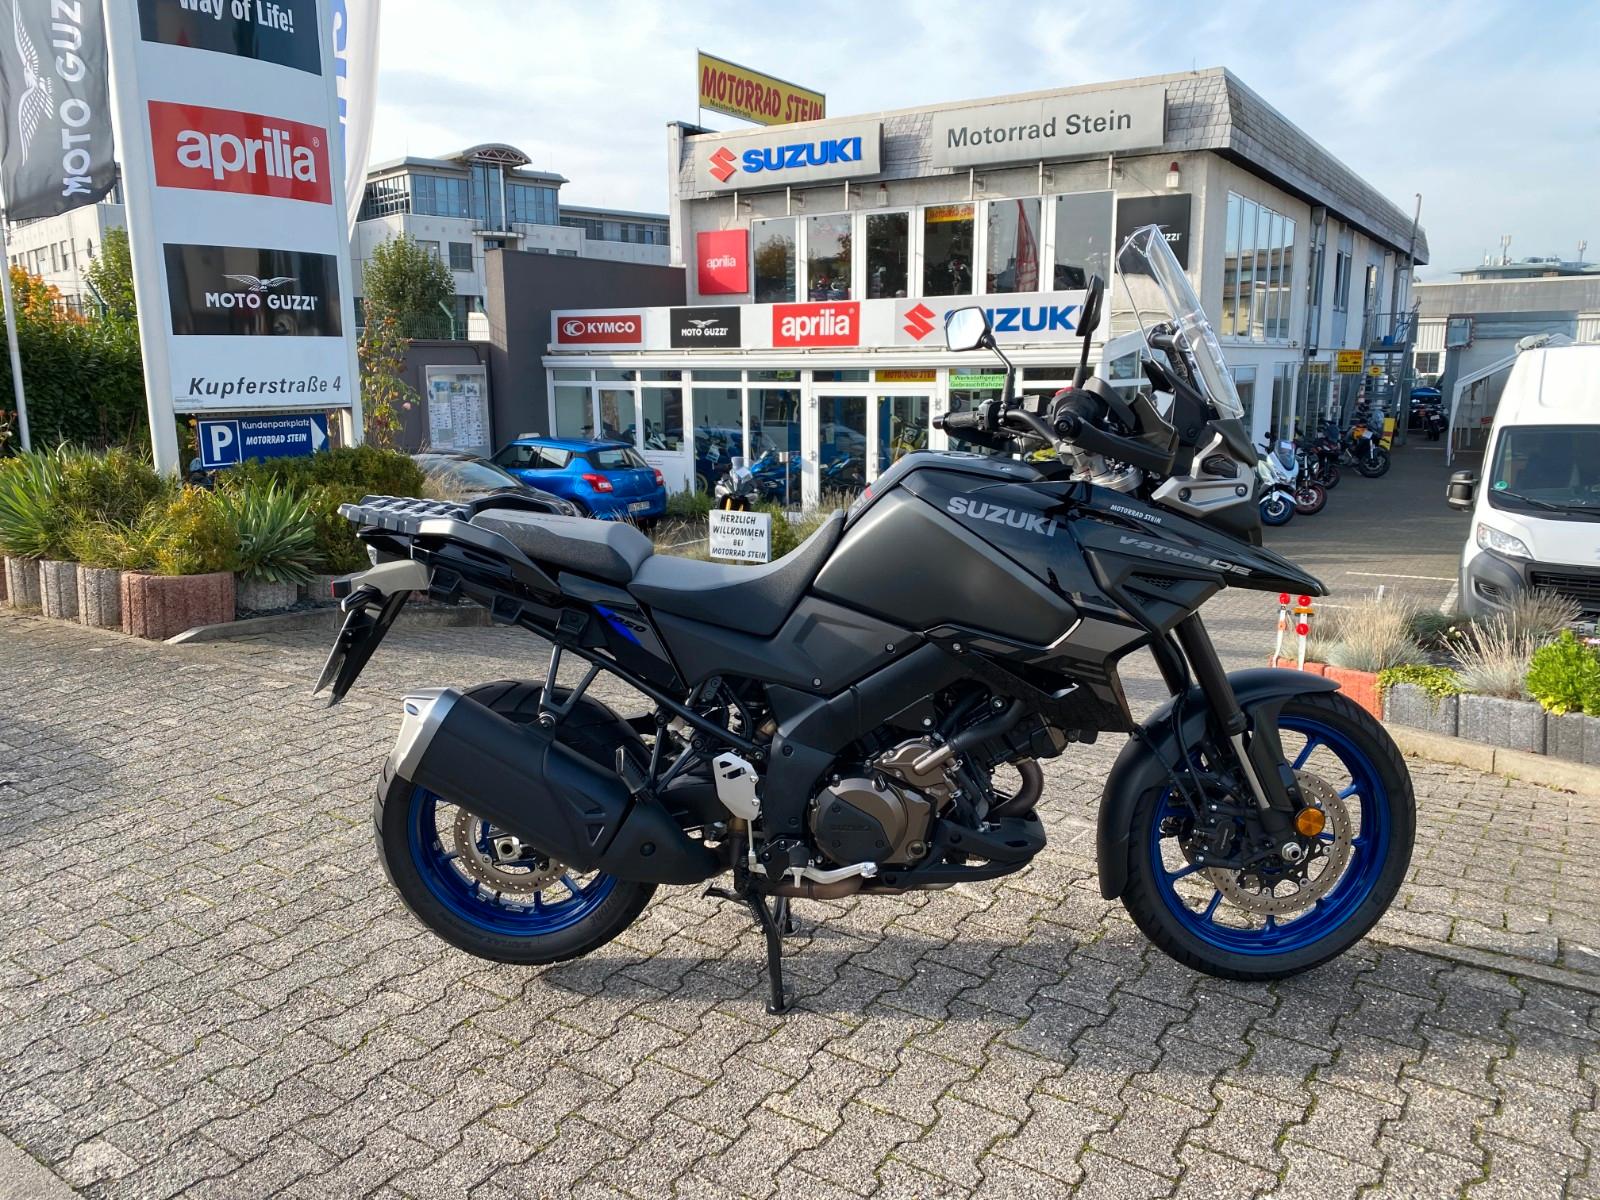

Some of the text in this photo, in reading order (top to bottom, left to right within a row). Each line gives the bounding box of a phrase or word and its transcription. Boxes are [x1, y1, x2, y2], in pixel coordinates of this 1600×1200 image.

[231, 0, 252, 22] of
[256, 0, 295, 33] Life!
[701, 65, 822, 122] MOTORRAD STEIN
[947, 109, 1131, 149] Motorrad Stein
[60, 98, 92, 197] MOTO
[176, 127, 318, 183] aprilia
[742, 136, 862, 173] SUZUKI
[706, 254, 737, 270] aprilia
[205, 292, 316, 311] MOTO GUZZI
[587, 321, 636, 334] KYMCO
[781, 308, 850, 341] aprilia
[944, 304, 1084, 332] ZUK
[681, 327, 727, 337] MOTO GUZZI
[189, 375, 341, 399] Kupferstraße 4
[241, 418, 310, 430] Kundenparkplatz
[210, 425, 233, 462] P
[245, 433, 307, 446] MOTORRAD STEIN
[721, 514, 757, 525] HERZLICH
[947, 496, 1058, 537] SUZUKI
[1110, 504, 1162, 524] MOTORRAD STEIN
[712, 525, 765, 538] WILLKOMMEN
[712, 547, 767, 560] MOTORRAD STEIN
[733, 539, 744, 547] BEI
